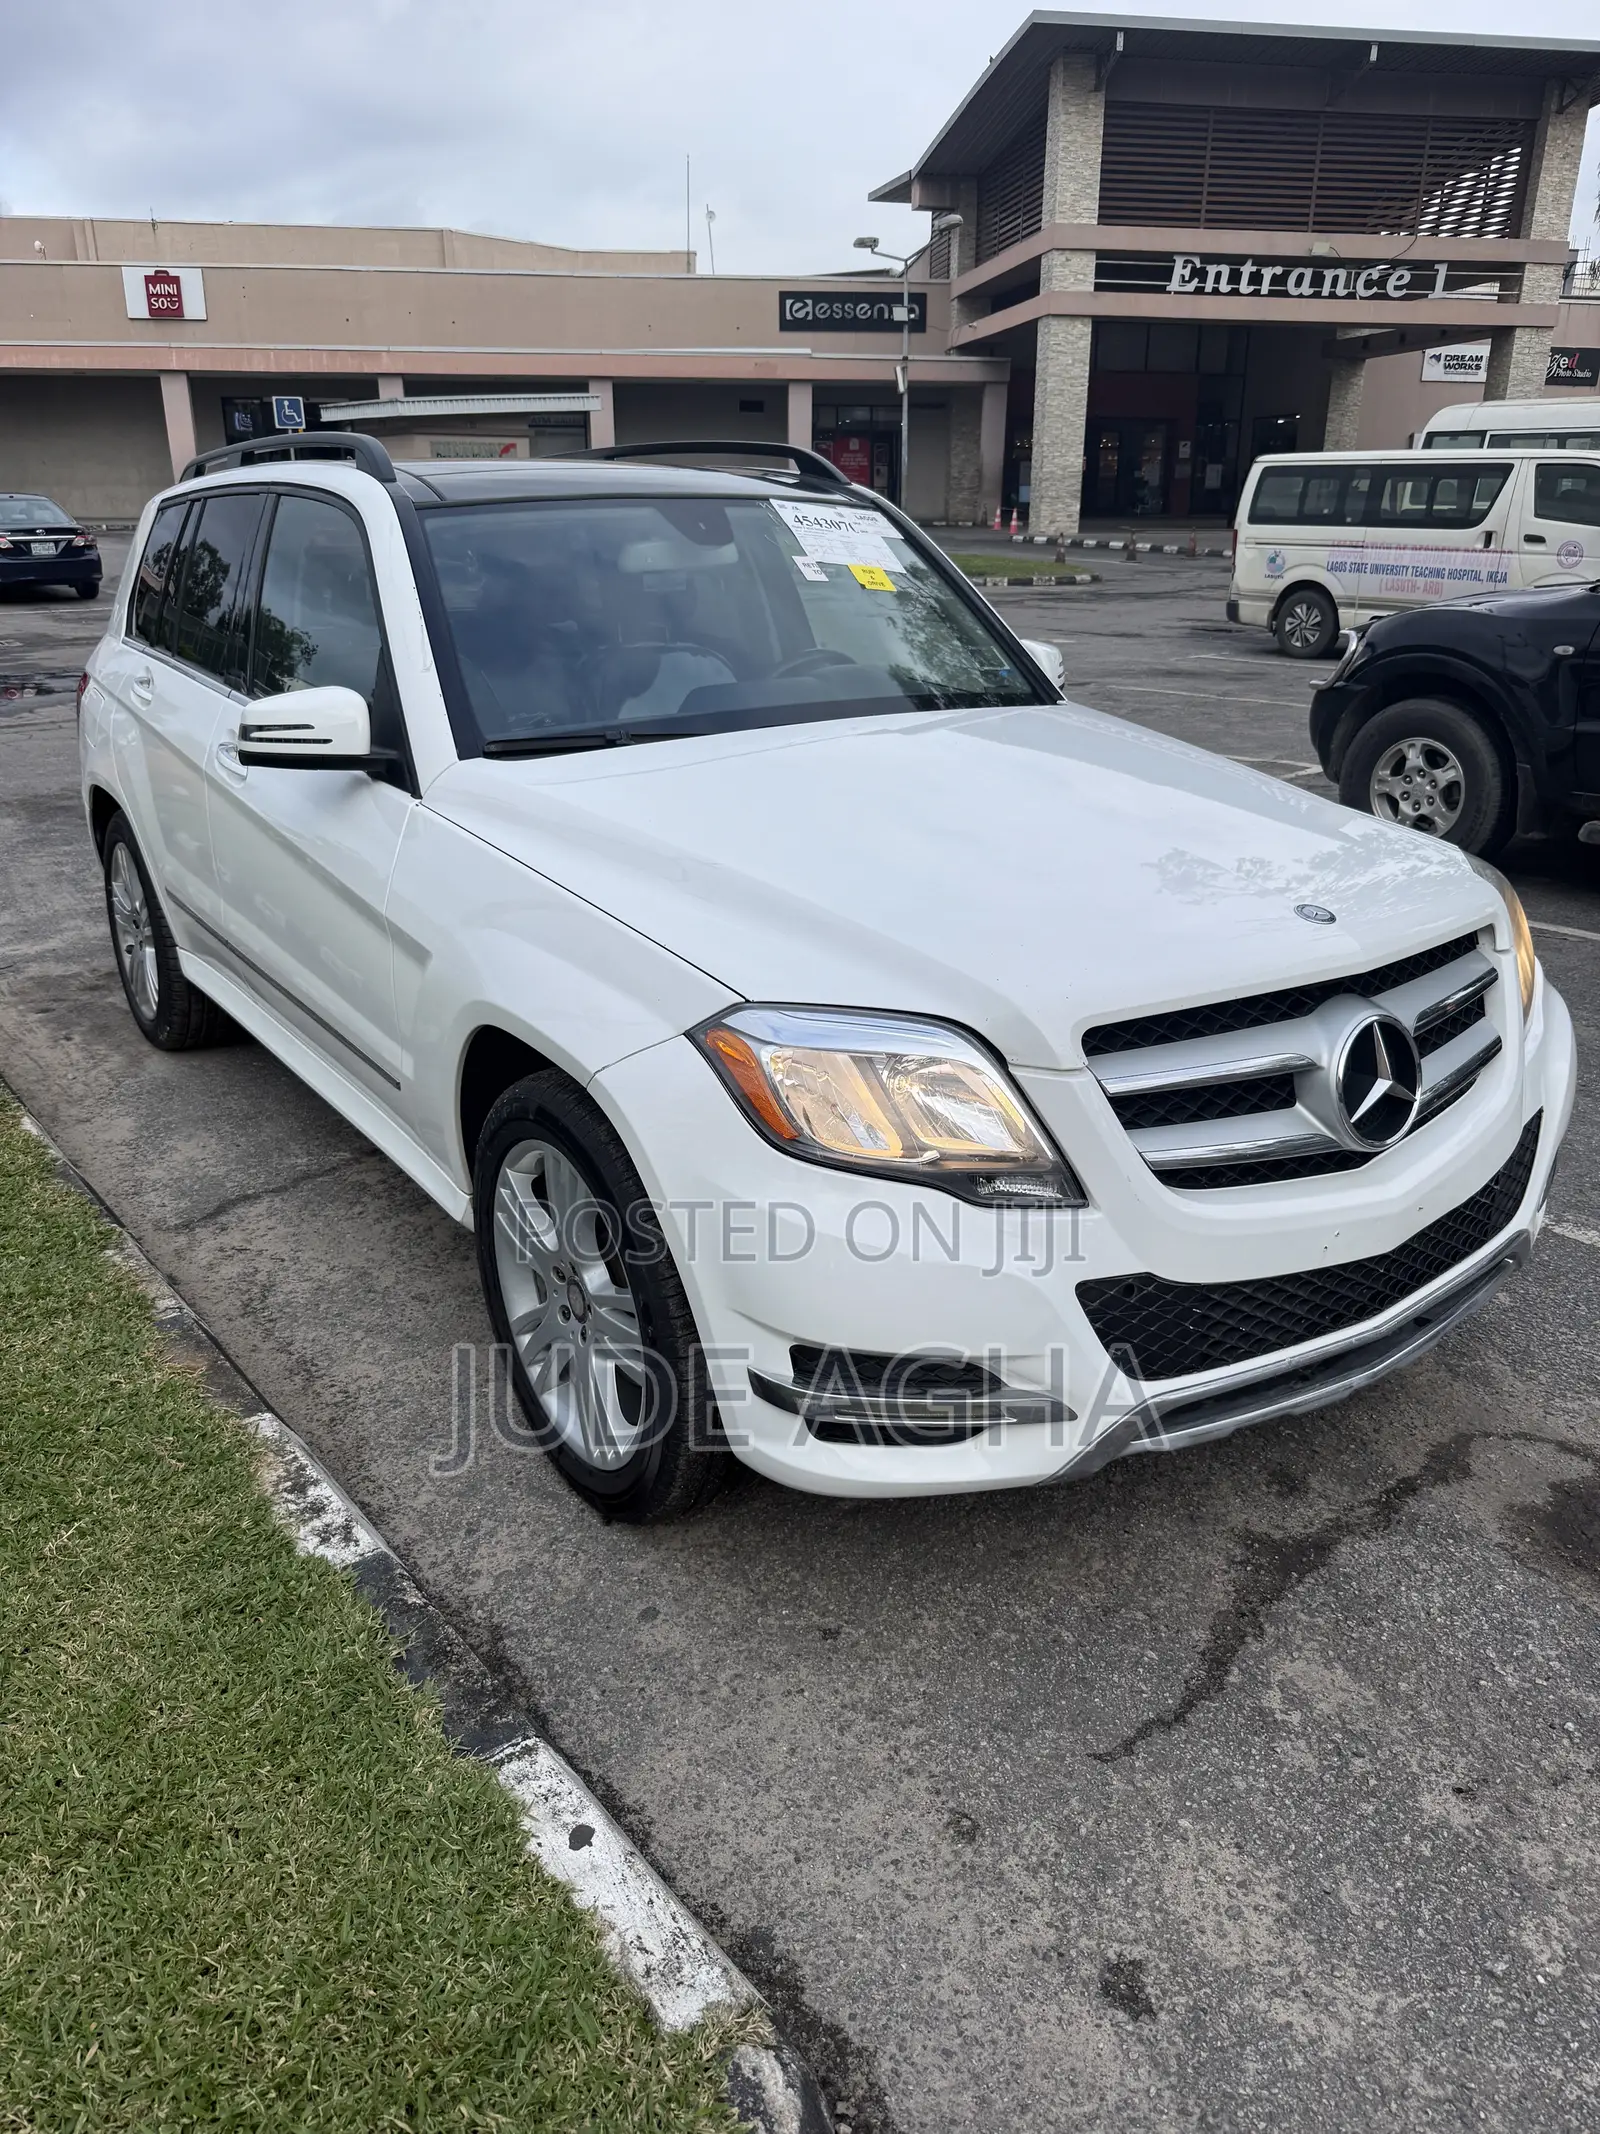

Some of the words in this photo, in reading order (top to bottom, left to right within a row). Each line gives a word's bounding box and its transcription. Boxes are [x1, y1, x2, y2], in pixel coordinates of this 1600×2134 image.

[1166, 254, 1412, 298] Entrance
[1428, 262, 1449, 299] 1
[148, 283, 178, 295] MINI
[815, 302, 920, 320] essena
[1443, 354, 1484, 363] DREAM
[1443, 362, 1482, 371] WORKS
[1554, 368, 1572, 377] Photo
[1572, 368, 1592, 378] Studio
[1326, 561, 1347, 573] LAGOS
[1349, 562, 1368, 574] STATE
[1369, 563, 1410, 578] UNIVERSITY
[1411, 565, 1446, 579] TEACHING
[1447, 567, 1484, 583] HOSPITAL,
[1486, 570, 1508, 583] IKEJA
